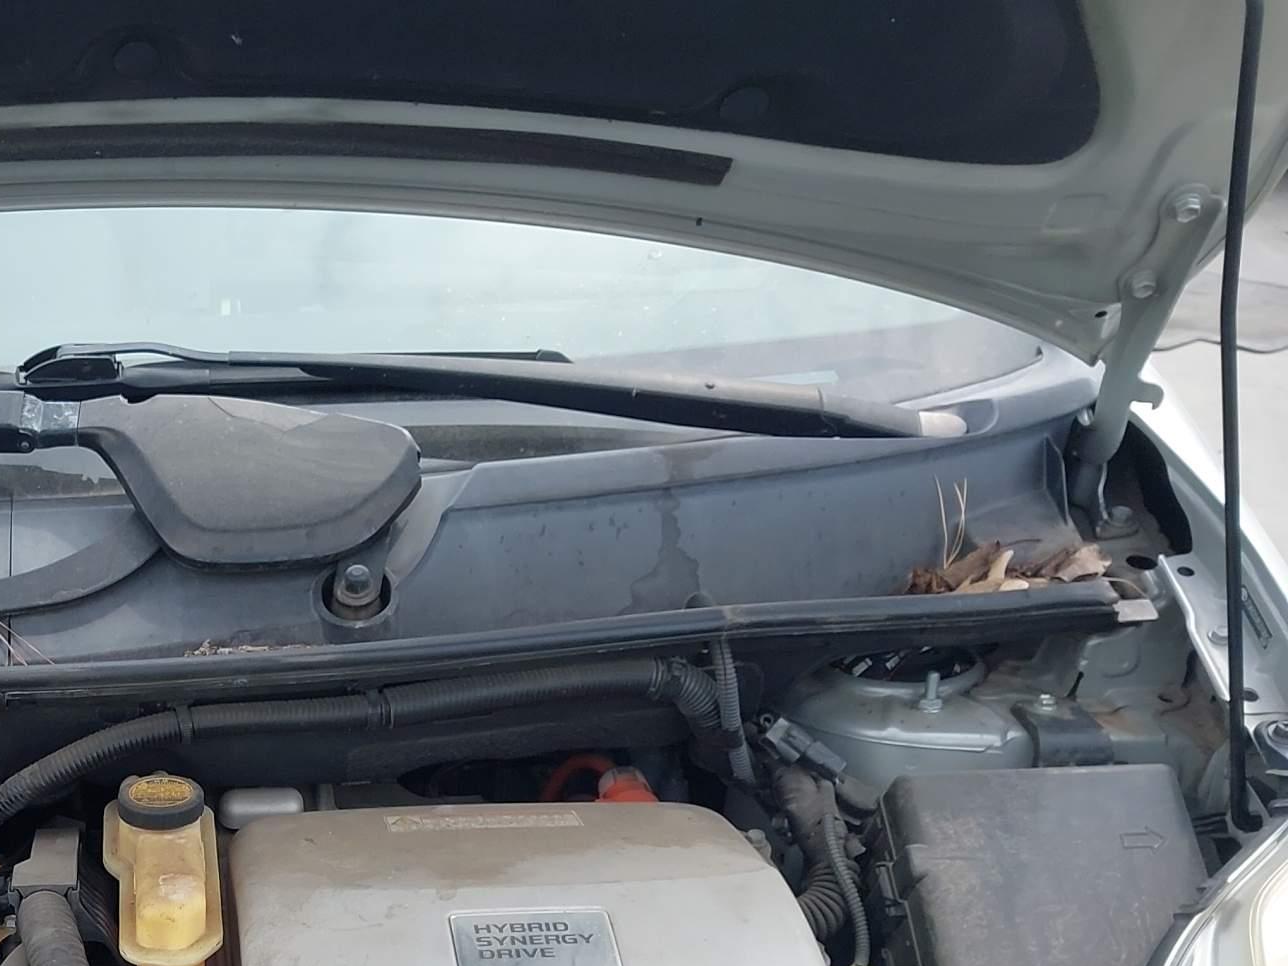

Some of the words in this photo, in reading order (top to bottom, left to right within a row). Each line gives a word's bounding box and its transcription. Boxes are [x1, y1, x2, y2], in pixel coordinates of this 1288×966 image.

[473, 922, 569, 934] HYBRID
[475, 934, 594, 947] SYNERGY
[479, 947, 556, 960] DRIVE
